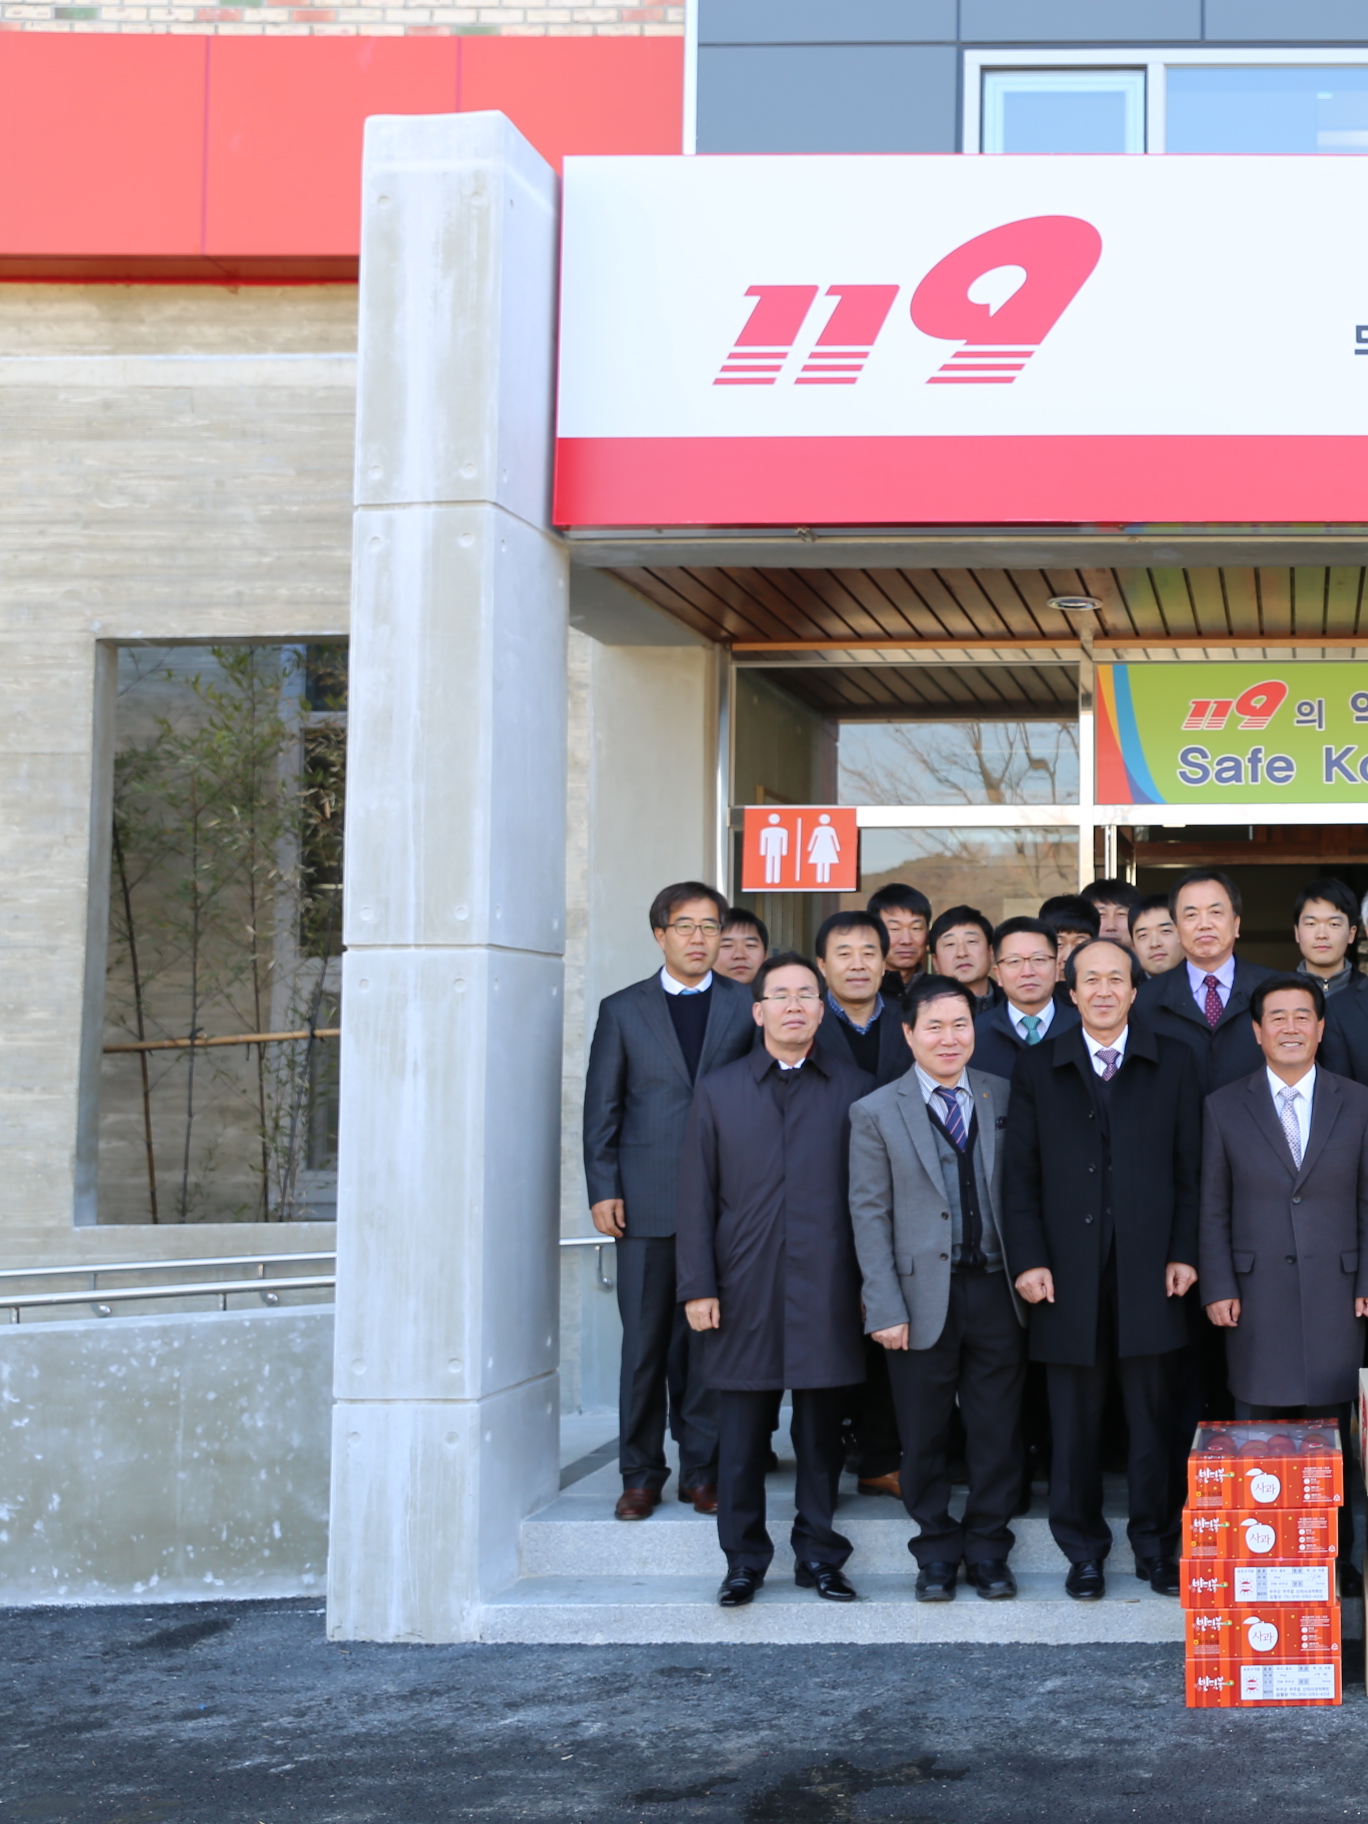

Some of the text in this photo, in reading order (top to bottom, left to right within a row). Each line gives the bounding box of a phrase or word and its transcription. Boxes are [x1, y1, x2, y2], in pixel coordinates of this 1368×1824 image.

[714, 215, 1102, 385] 119
[1179, 747, 1295, 784] Safe
[1254, 1482, 1276, 1494] 사과
[1250, 1532, 1271, 1545] 사과
[1252, 1630, 1274, 1643] 사과
